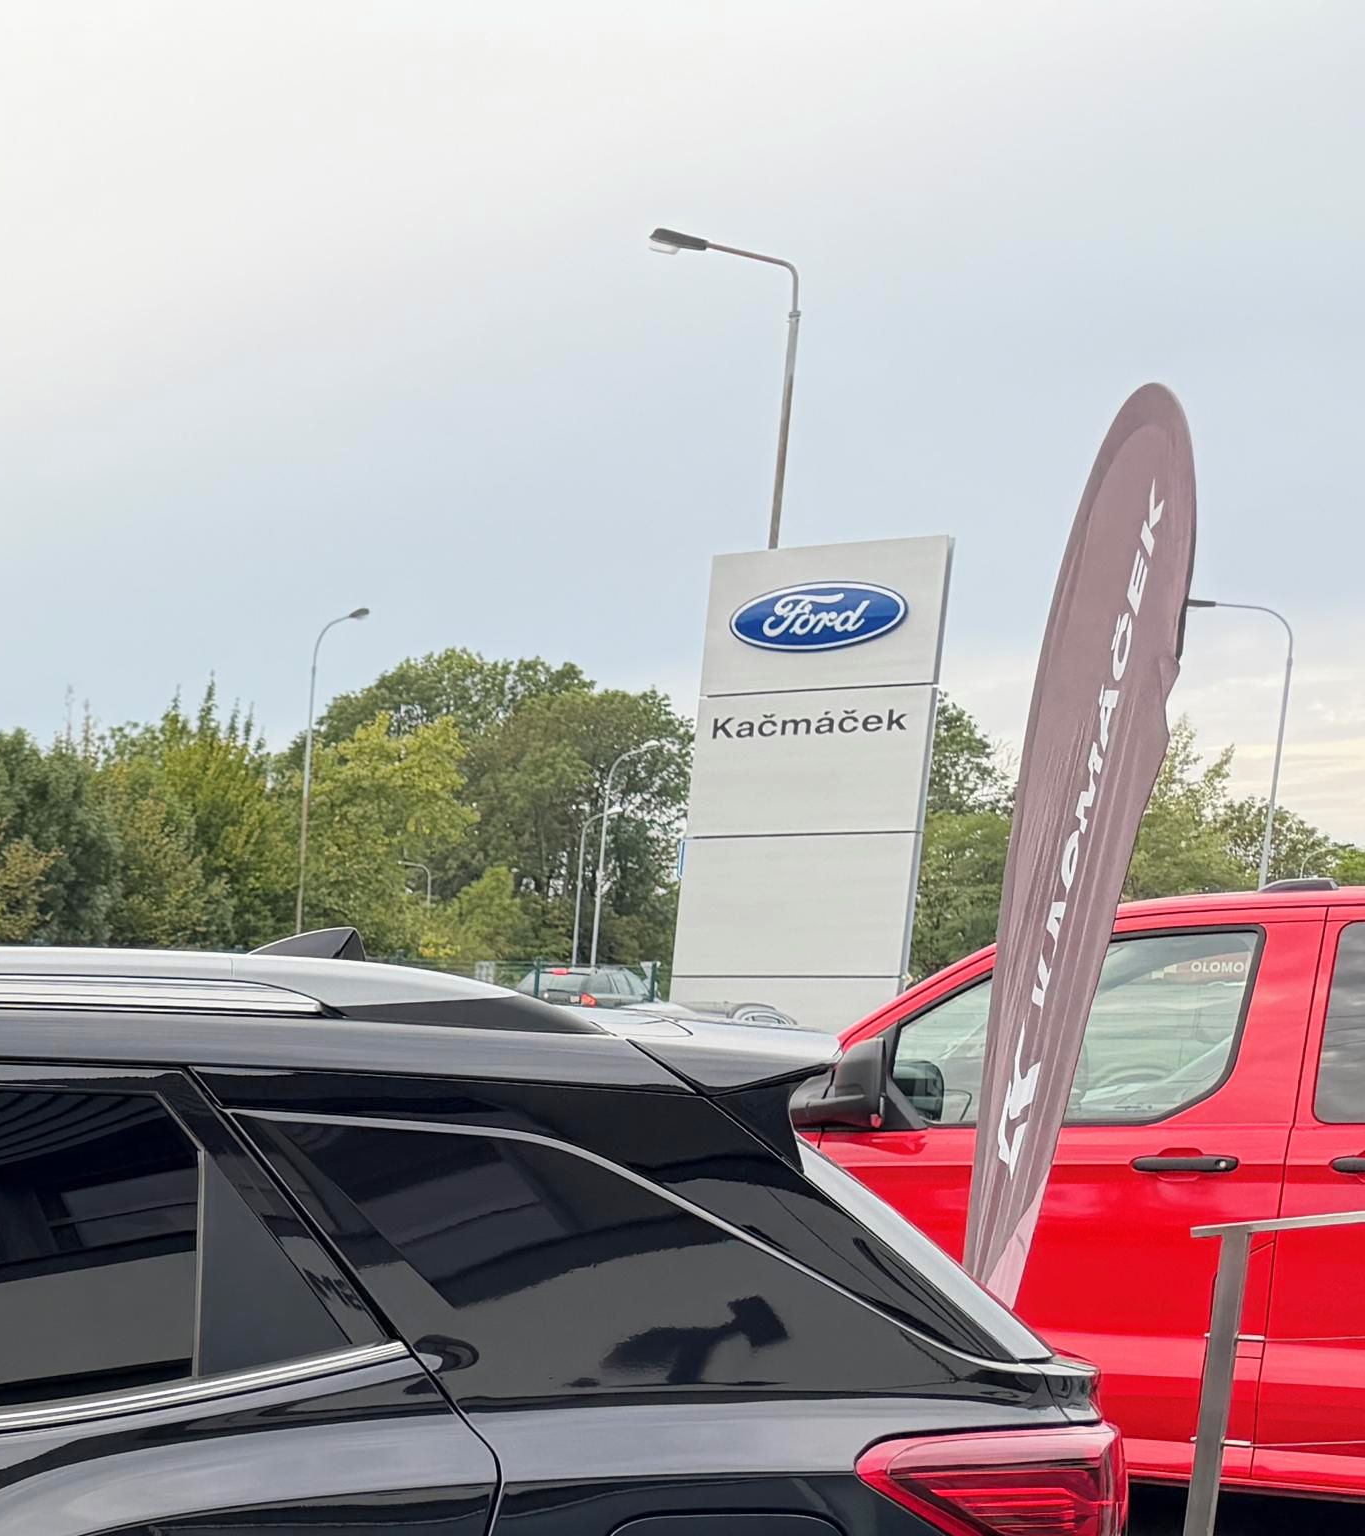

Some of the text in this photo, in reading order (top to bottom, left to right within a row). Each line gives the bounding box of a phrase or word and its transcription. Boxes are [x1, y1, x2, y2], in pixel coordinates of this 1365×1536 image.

[763, 592, 871, 638] Ford
[711, 708, 908, 739] Kačmáček
[1190, 960, 1249, 974] OLOMO
